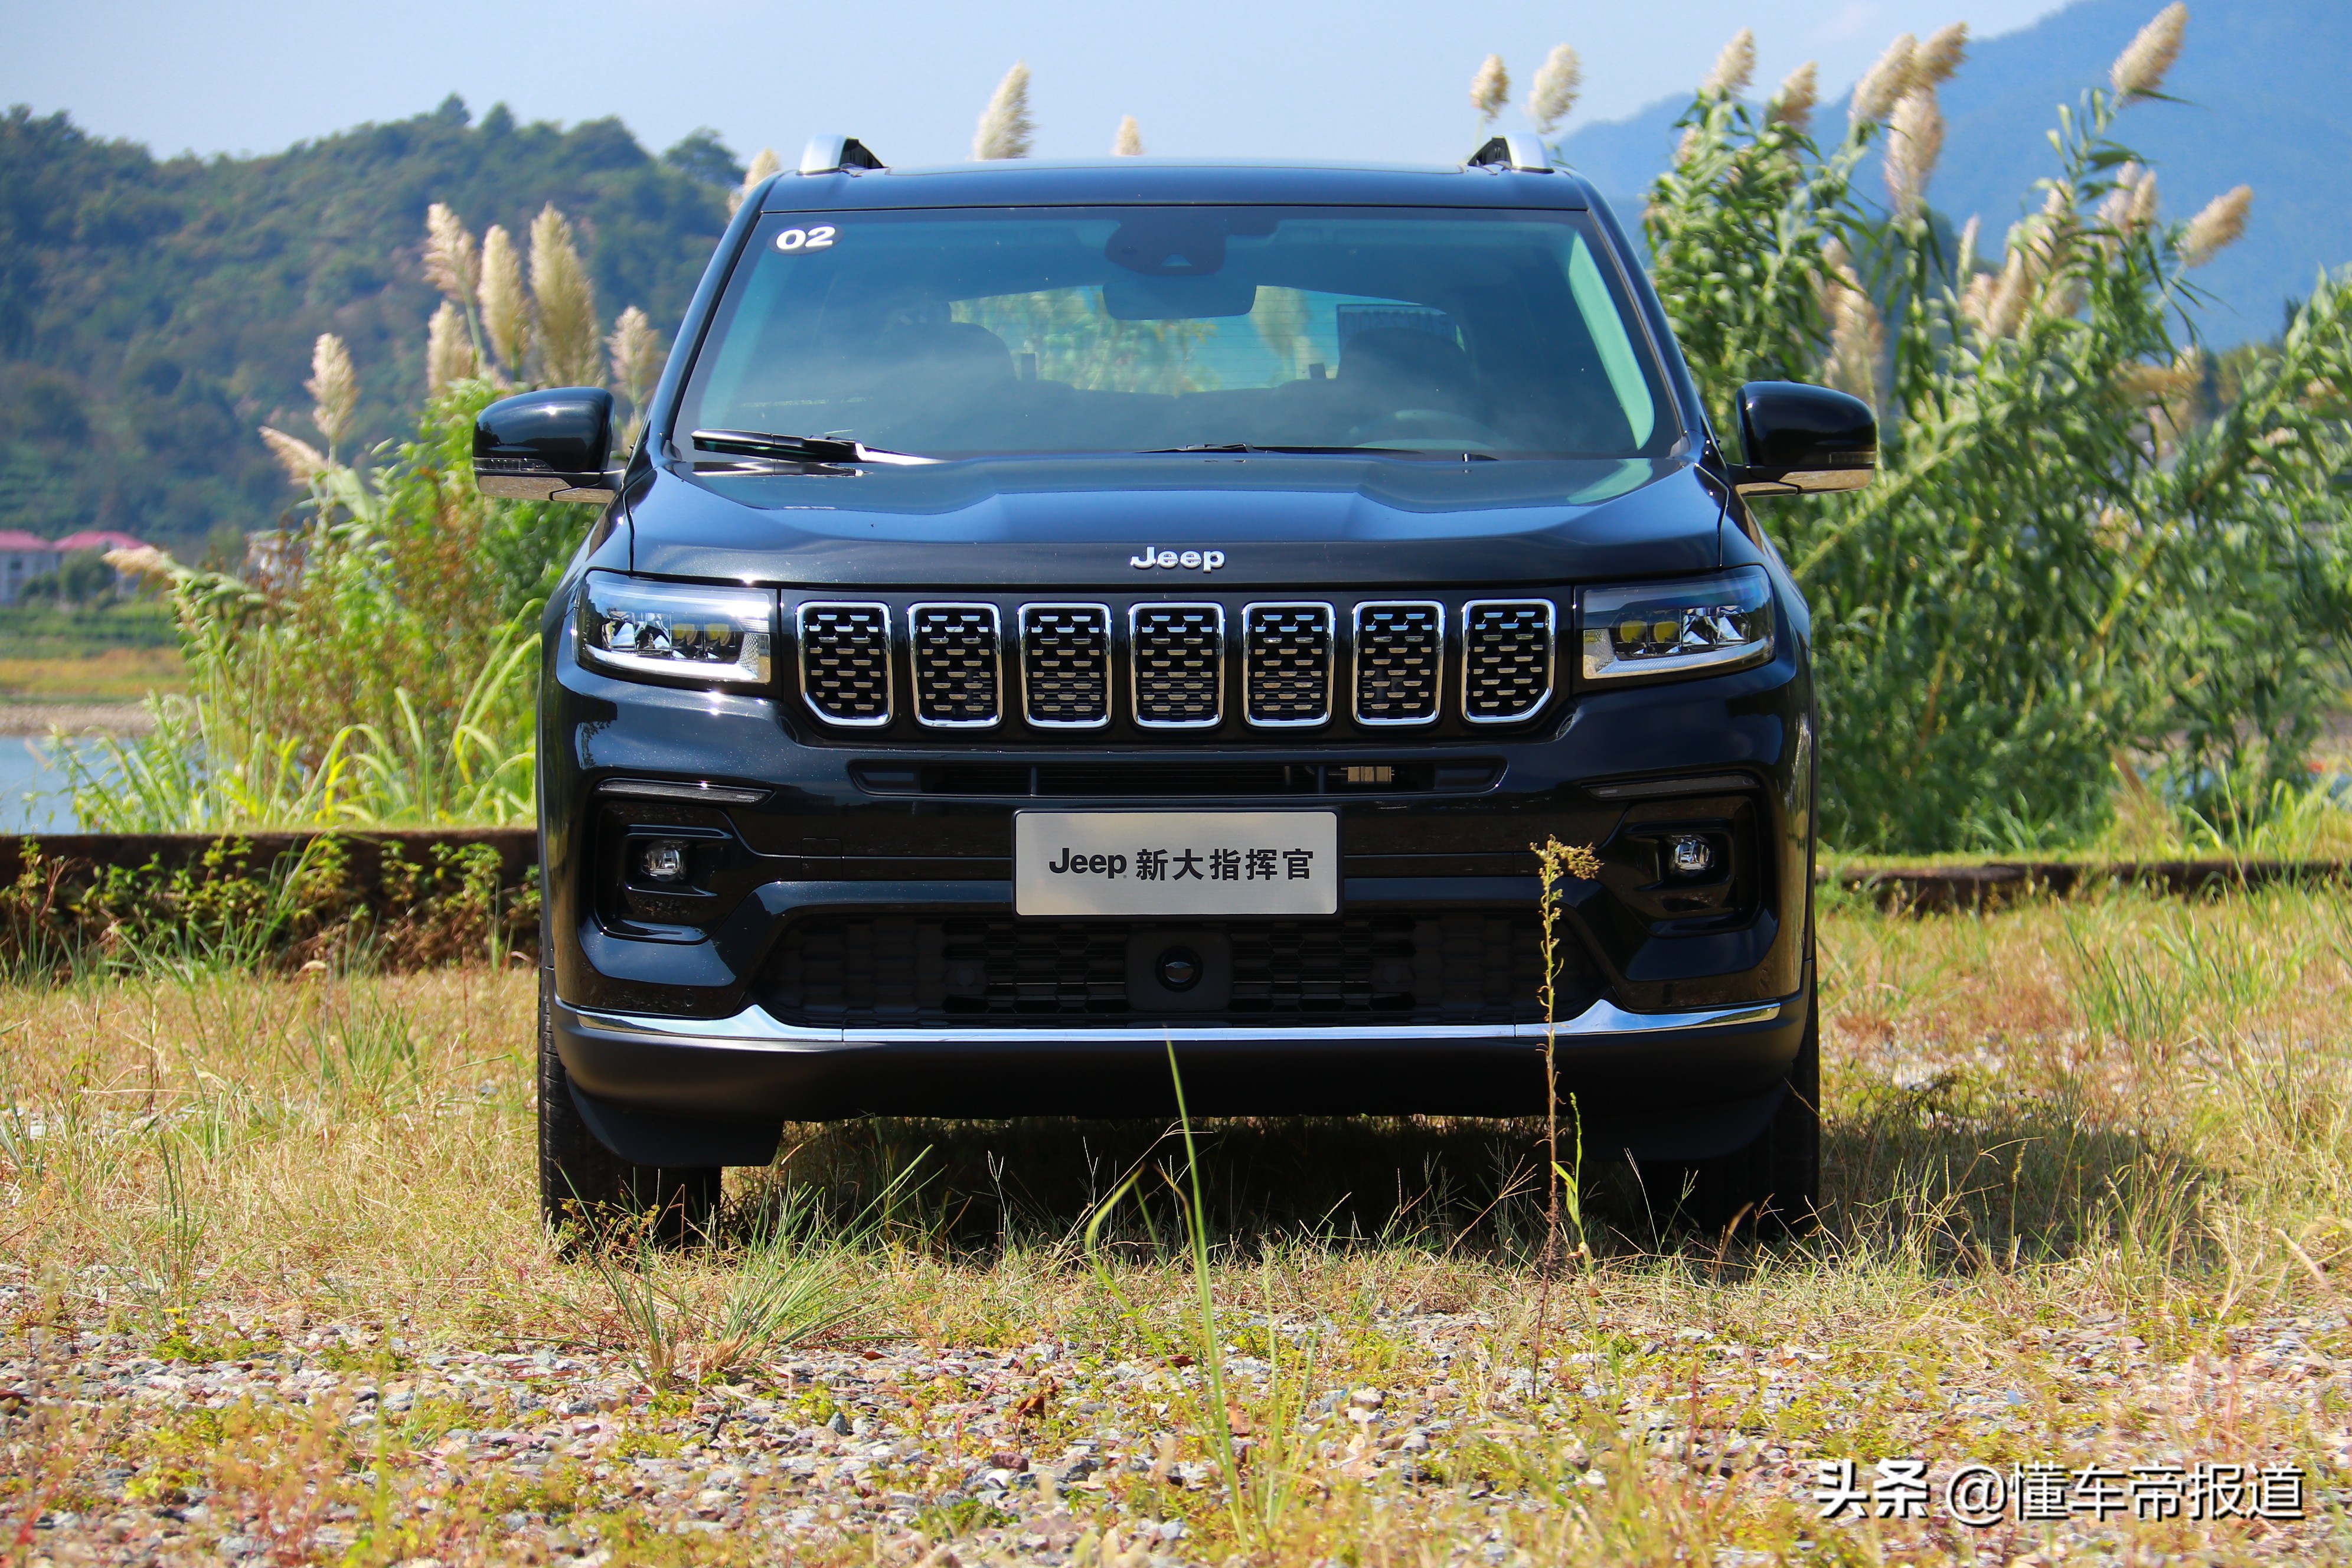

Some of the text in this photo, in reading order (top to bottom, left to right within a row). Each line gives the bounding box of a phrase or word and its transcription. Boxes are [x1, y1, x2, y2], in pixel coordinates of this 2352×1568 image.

[776, 226, 835, 250] 02
[1130, 545, 1225, 573] Jeep
[1048, 847, 1314, 881] Jeep 新大指挥官
